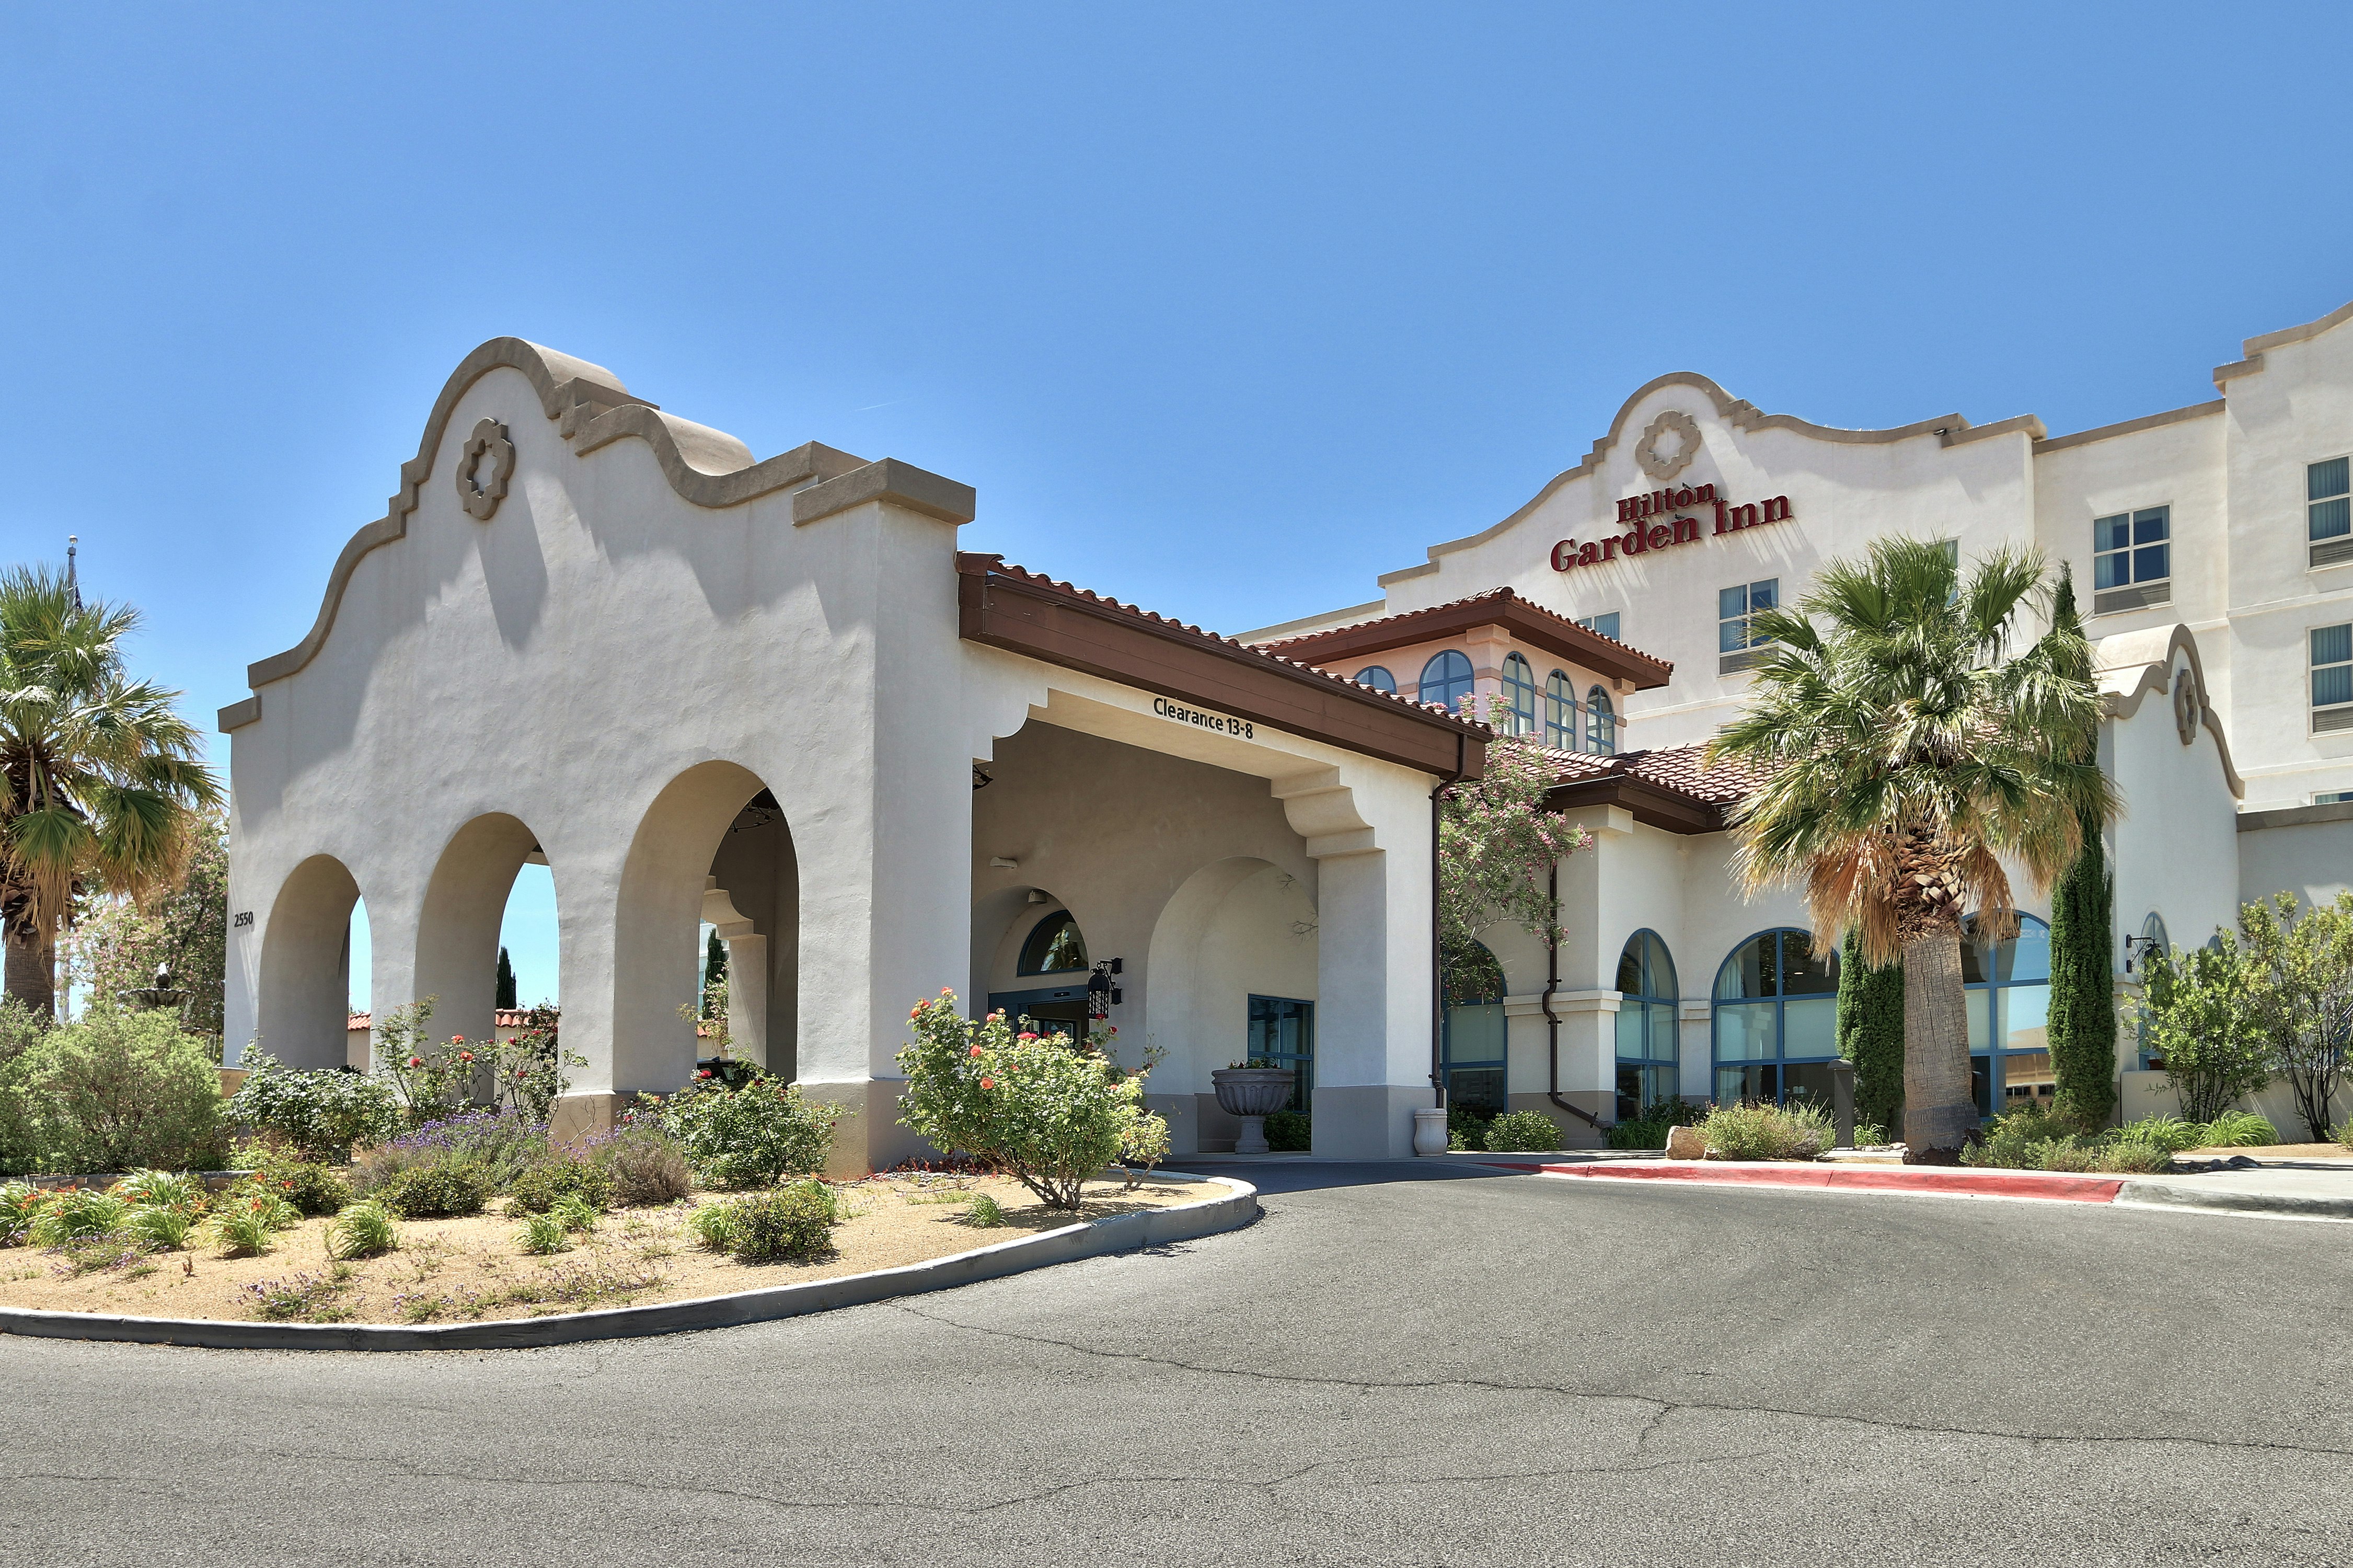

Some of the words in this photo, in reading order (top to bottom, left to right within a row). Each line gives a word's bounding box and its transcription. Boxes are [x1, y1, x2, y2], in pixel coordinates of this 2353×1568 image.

[1616, 482, 1718, 524] Hilton
[1550, 516, 1702, 573] Garden
[1712, 494, 1793, 537] Inn
[1154, 697, 1224, 731] Clearance
[1226, 718, 1253, 740] 13-8
[234, 911, 253, 928] 2550
